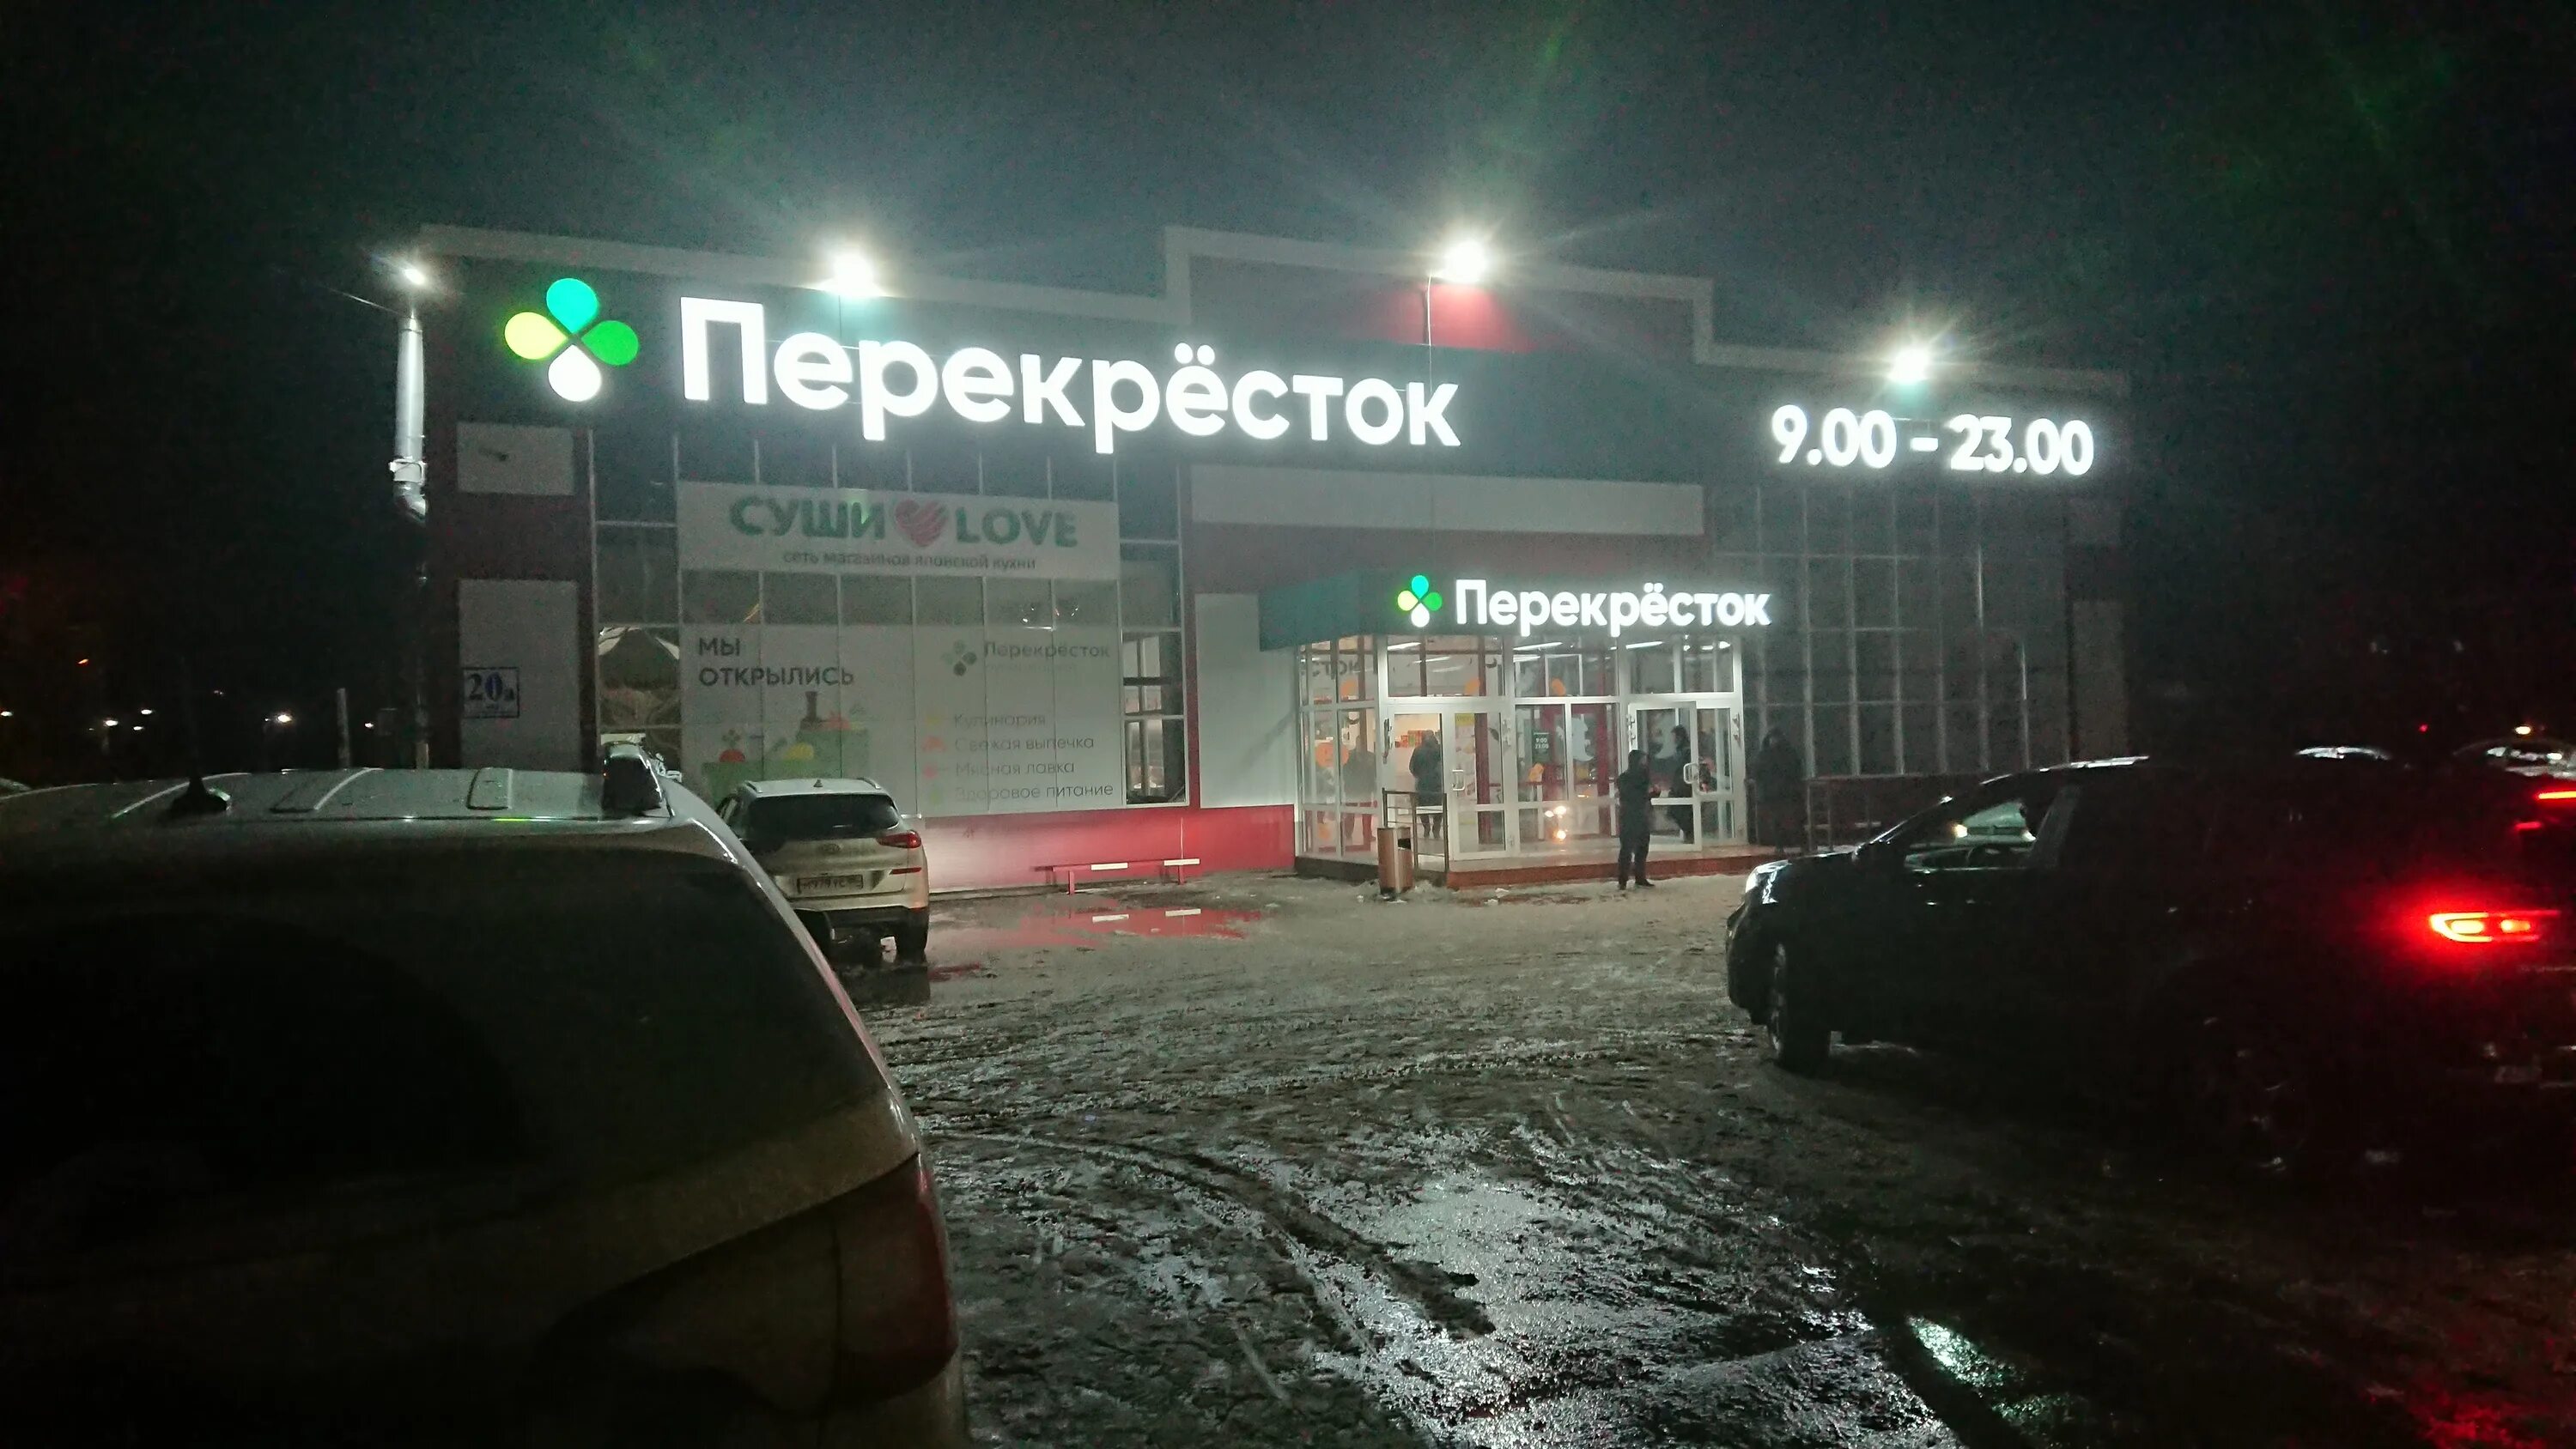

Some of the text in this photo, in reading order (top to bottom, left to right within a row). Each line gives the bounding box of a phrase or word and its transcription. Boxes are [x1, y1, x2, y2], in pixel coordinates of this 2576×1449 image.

[680, 296, 1461, 454] Перекрёсток
[1771, 404, 1898, 469] 9.00
[1947, 414, 2095, 476] 23.00
[730, 495, 1078, 548] СУШИ LOVE
[782, 551, 819, 565] сеть
[1455, 579, 1771, 638] Перекрёсток
[698, 637, 741, 657] МЫ
[698, 665, 854, 687] ОТКРЫЛИСЬ
[954, 713, 1046, 730] Кулинария
[955, 737, 1095, 752] Свежая выпечка
[1027, 762, 1075, 774] лавка
[1046, 784, 1114, 798] питание
